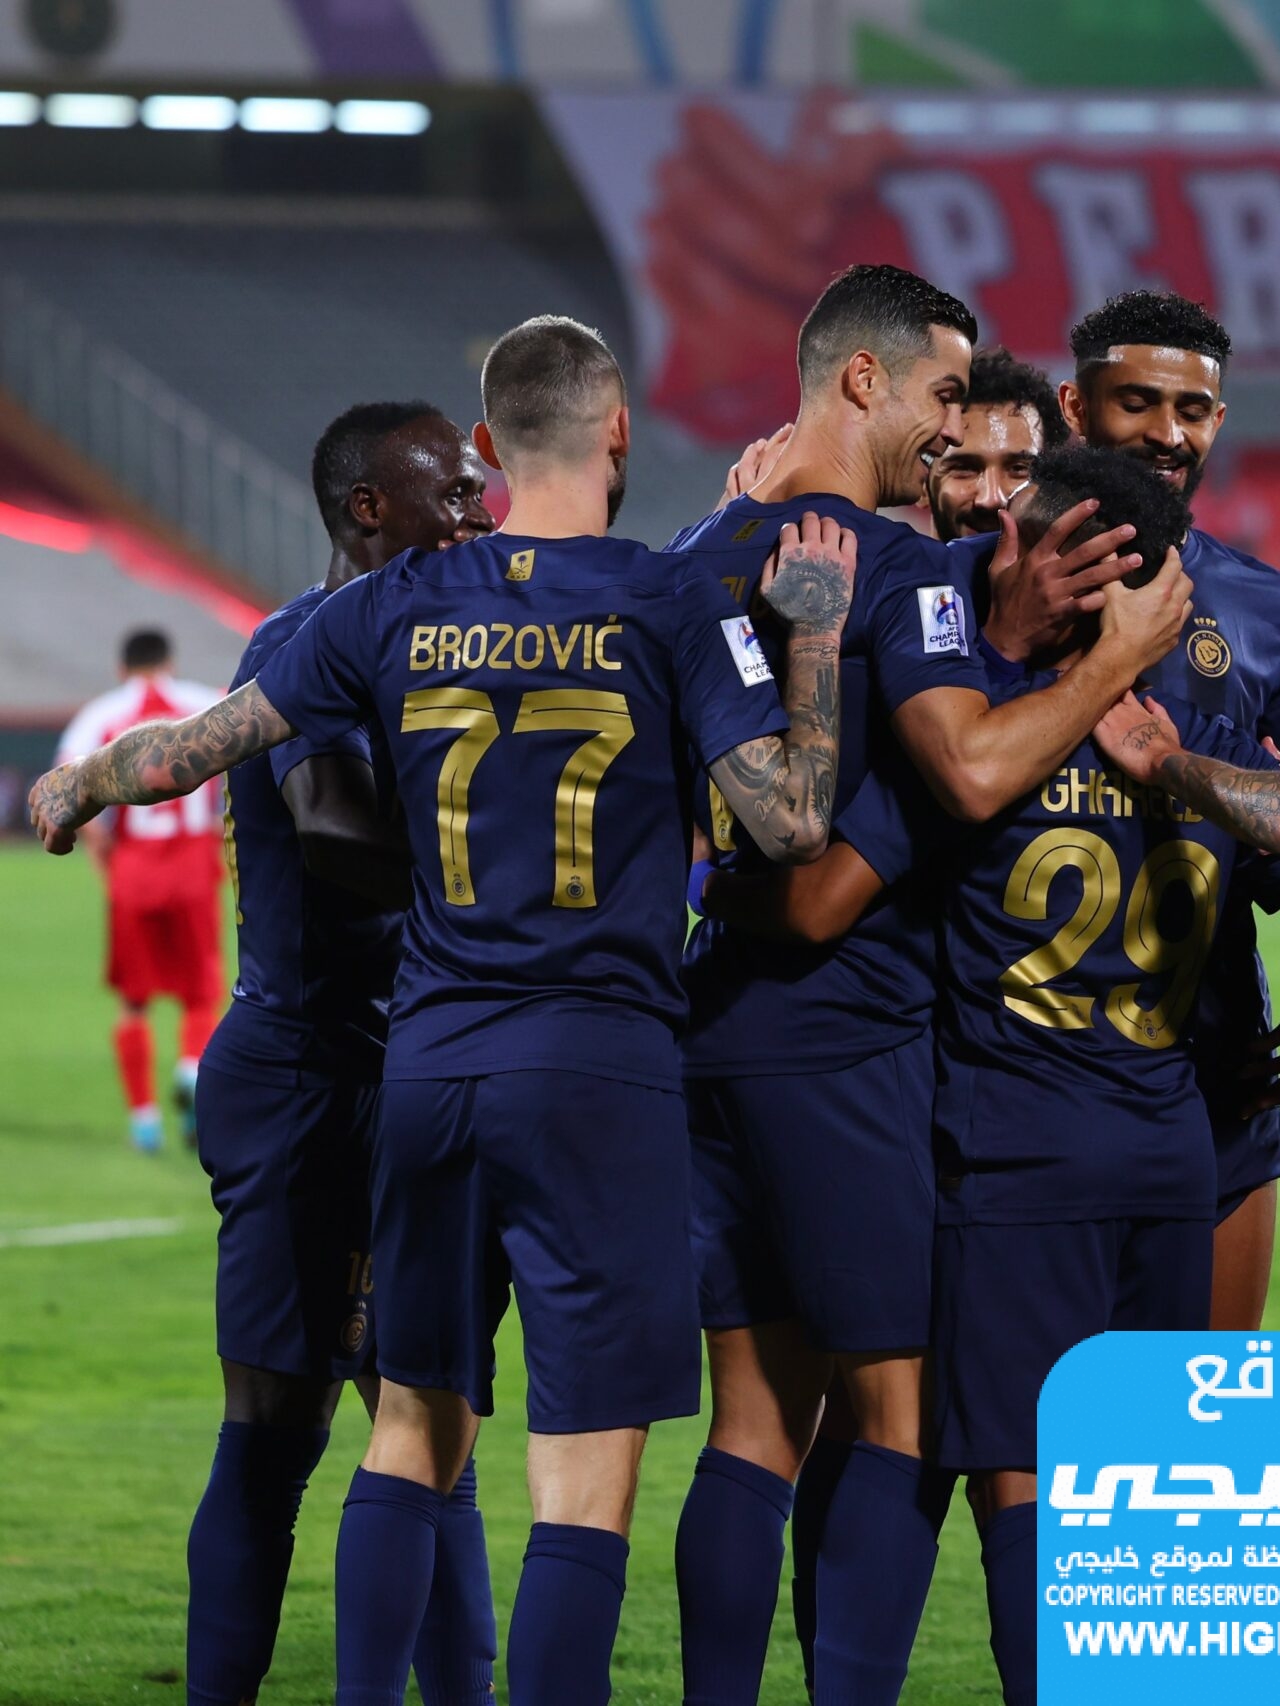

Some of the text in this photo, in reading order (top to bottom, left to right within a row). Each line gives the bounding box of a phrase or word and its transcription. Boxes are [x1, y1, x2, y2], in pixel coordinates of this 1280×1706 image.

[409, 614, 623, 671] BROZOVIĆ
[401, 687, 636, 908] 77
[998, 827, 1220, 1049] 29
